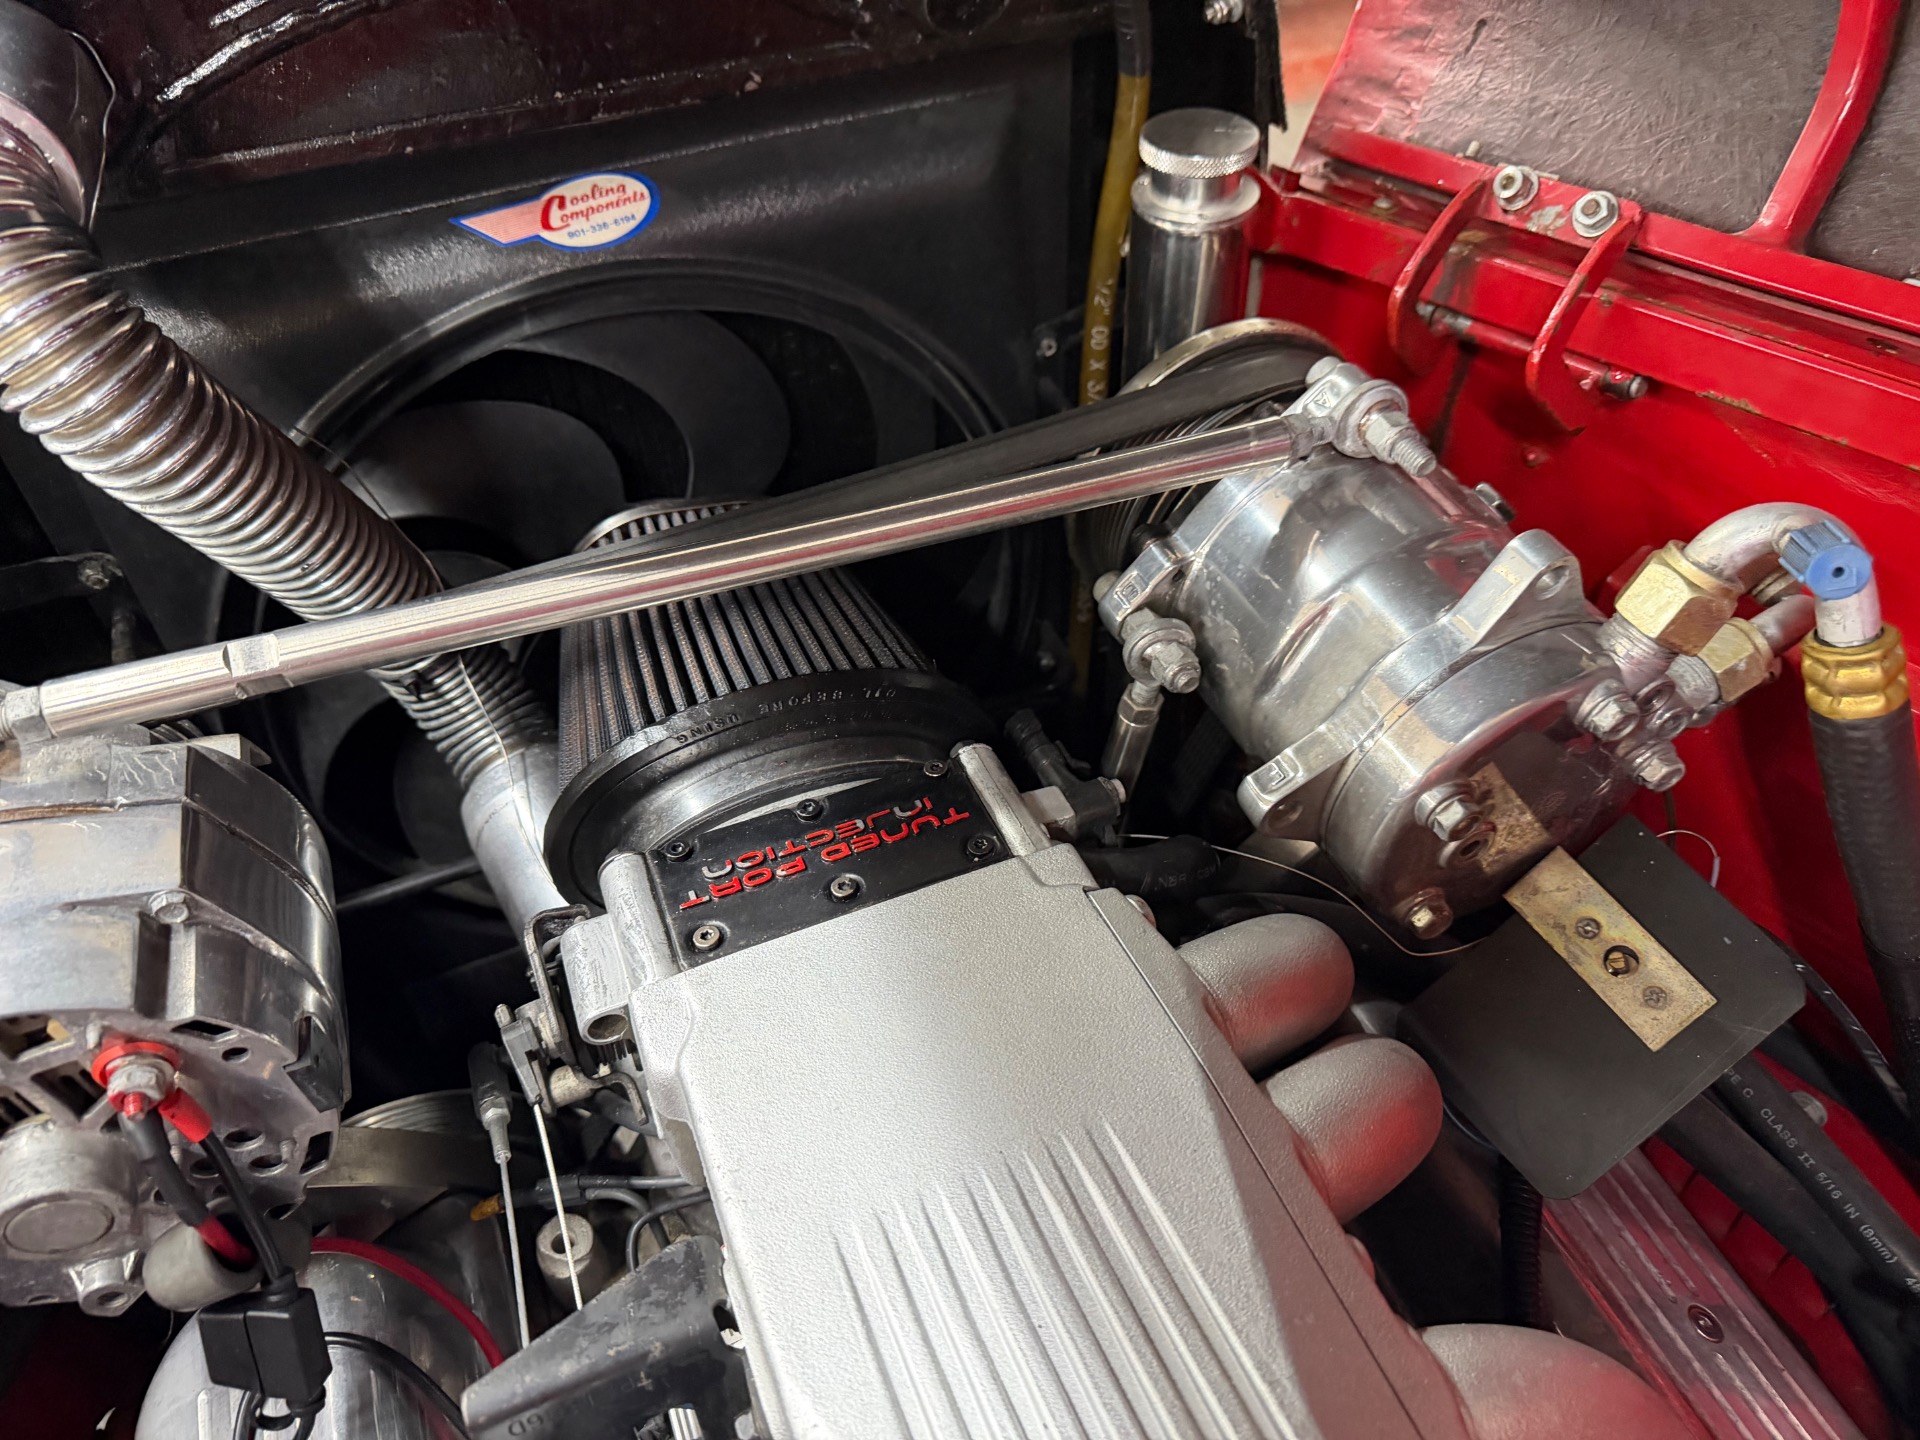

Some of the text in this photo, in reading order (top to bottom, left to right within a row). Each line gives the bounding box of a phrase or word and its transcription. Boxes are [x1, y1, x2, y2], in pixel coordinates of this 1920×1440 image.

[541, 190, 646, 231] Components
[676, 713, 741, 745] USING
[679, 807, 971, 910] TUNED PORT
[701, 796, 934, 880] INJECTION
[1742, 1087, 1754, 1098] C
[1760, 1108, 1799, 1148] CLASS
[1797, 1151, 1816, 1169] II
[1815, 1172, 1843, 1199] 5/16
[1843, 1203, 1860, 1220] IN
[1859, 1224, 1899, 1264] (8mm)
